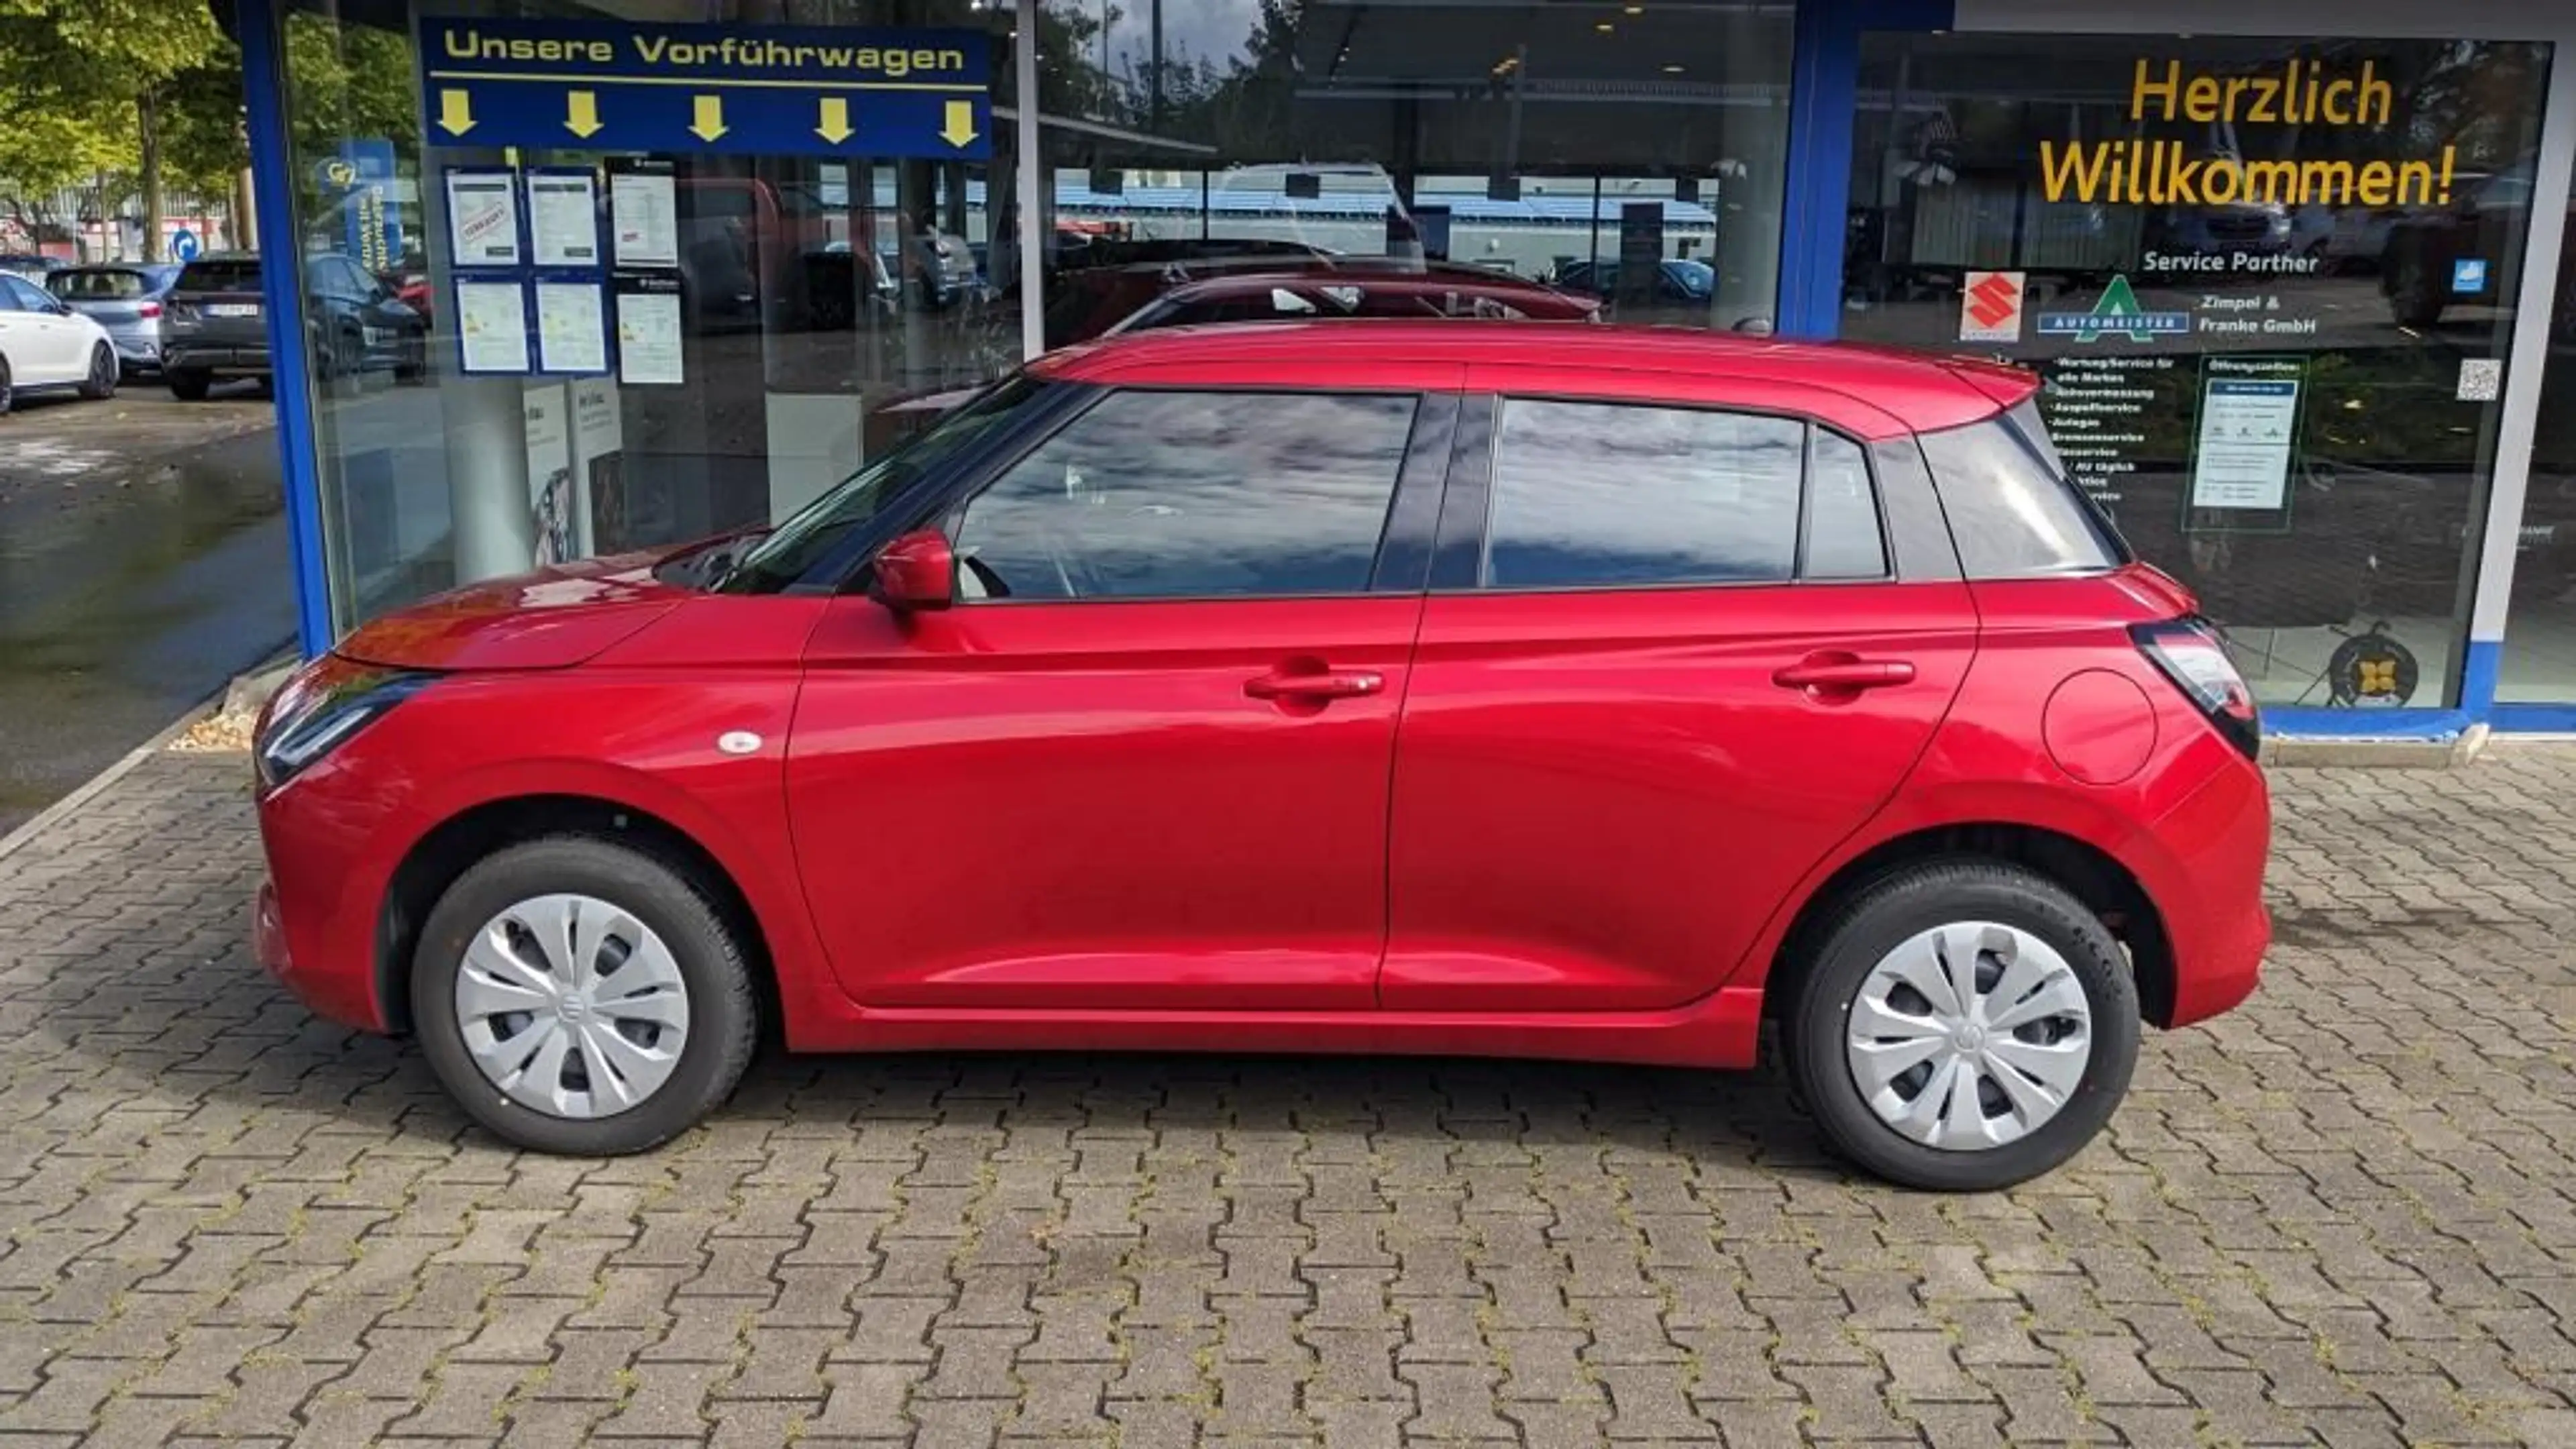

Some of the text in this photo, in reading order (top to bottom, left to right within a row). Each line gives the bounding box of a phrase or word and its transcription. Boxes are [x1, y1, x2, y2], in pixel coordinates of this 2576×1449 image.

[444, 30, 965, 77] Unsere Vorführwagen
[2130, 59, 2392, 125] Herzlich
[2039, 140, 2457, 207] Willkommen!
[2144, 251, 2319, 273] Service Partner
[2200, 296, 2280, 311] Zimpel &
[2053, 317, 2176, 329] AUTOMEISTER
[2198, 317, 2317, 333] Franke GmbH
